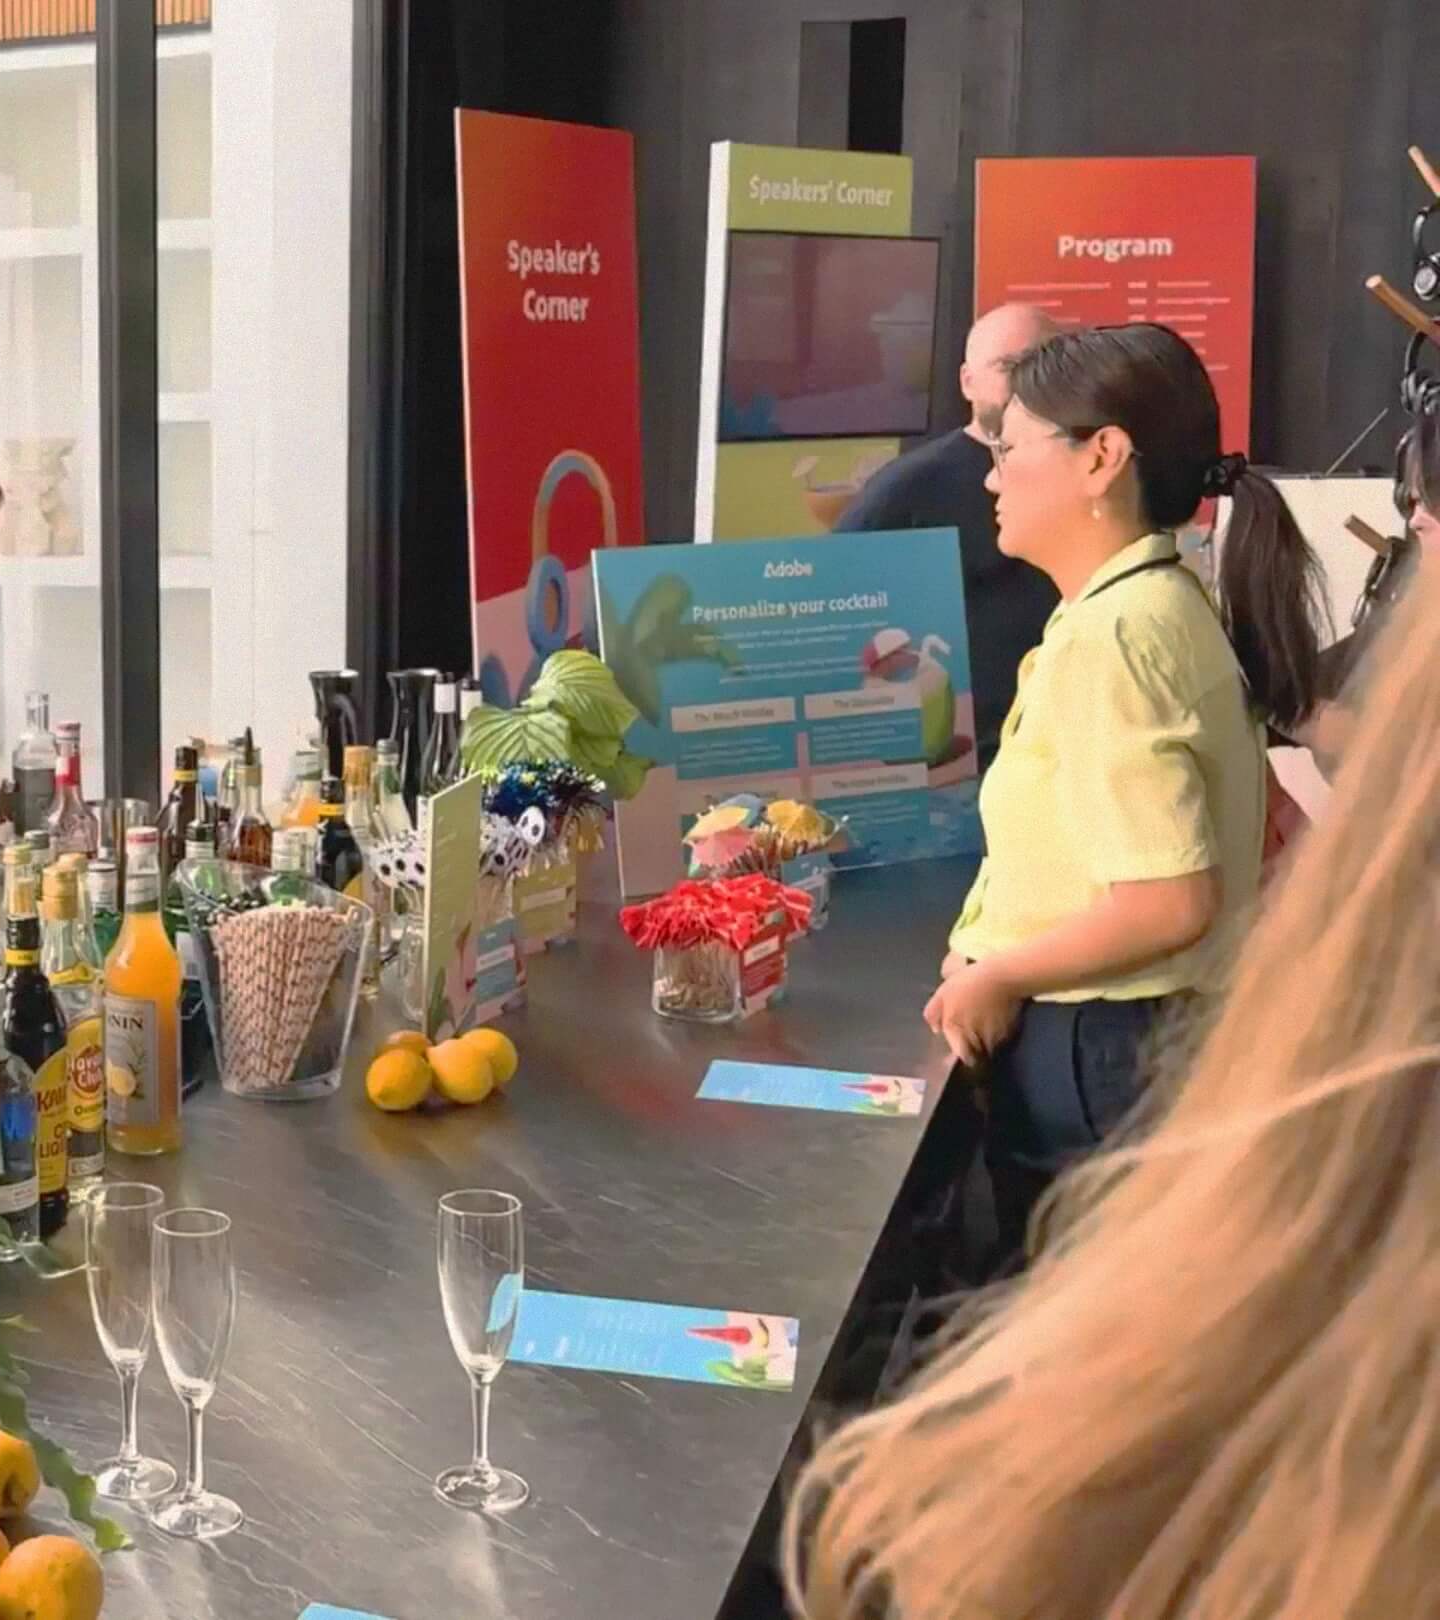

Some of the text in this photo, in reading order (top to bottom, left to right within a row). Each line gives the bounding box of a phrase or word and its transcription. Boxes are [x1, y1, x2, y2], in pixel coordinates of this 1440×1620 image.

[835, 181, 893, 208] Corner
[506, 238, 601, 280] Speaker's
[1057, 234, 1174, 263] Program
[522, 288, 589, 322] Corner
[763, 559, 814, 579] Adobe
[692, 591, 889, 623] Personalize your cocktail
[109, 1013, 145, 1031] NIN
